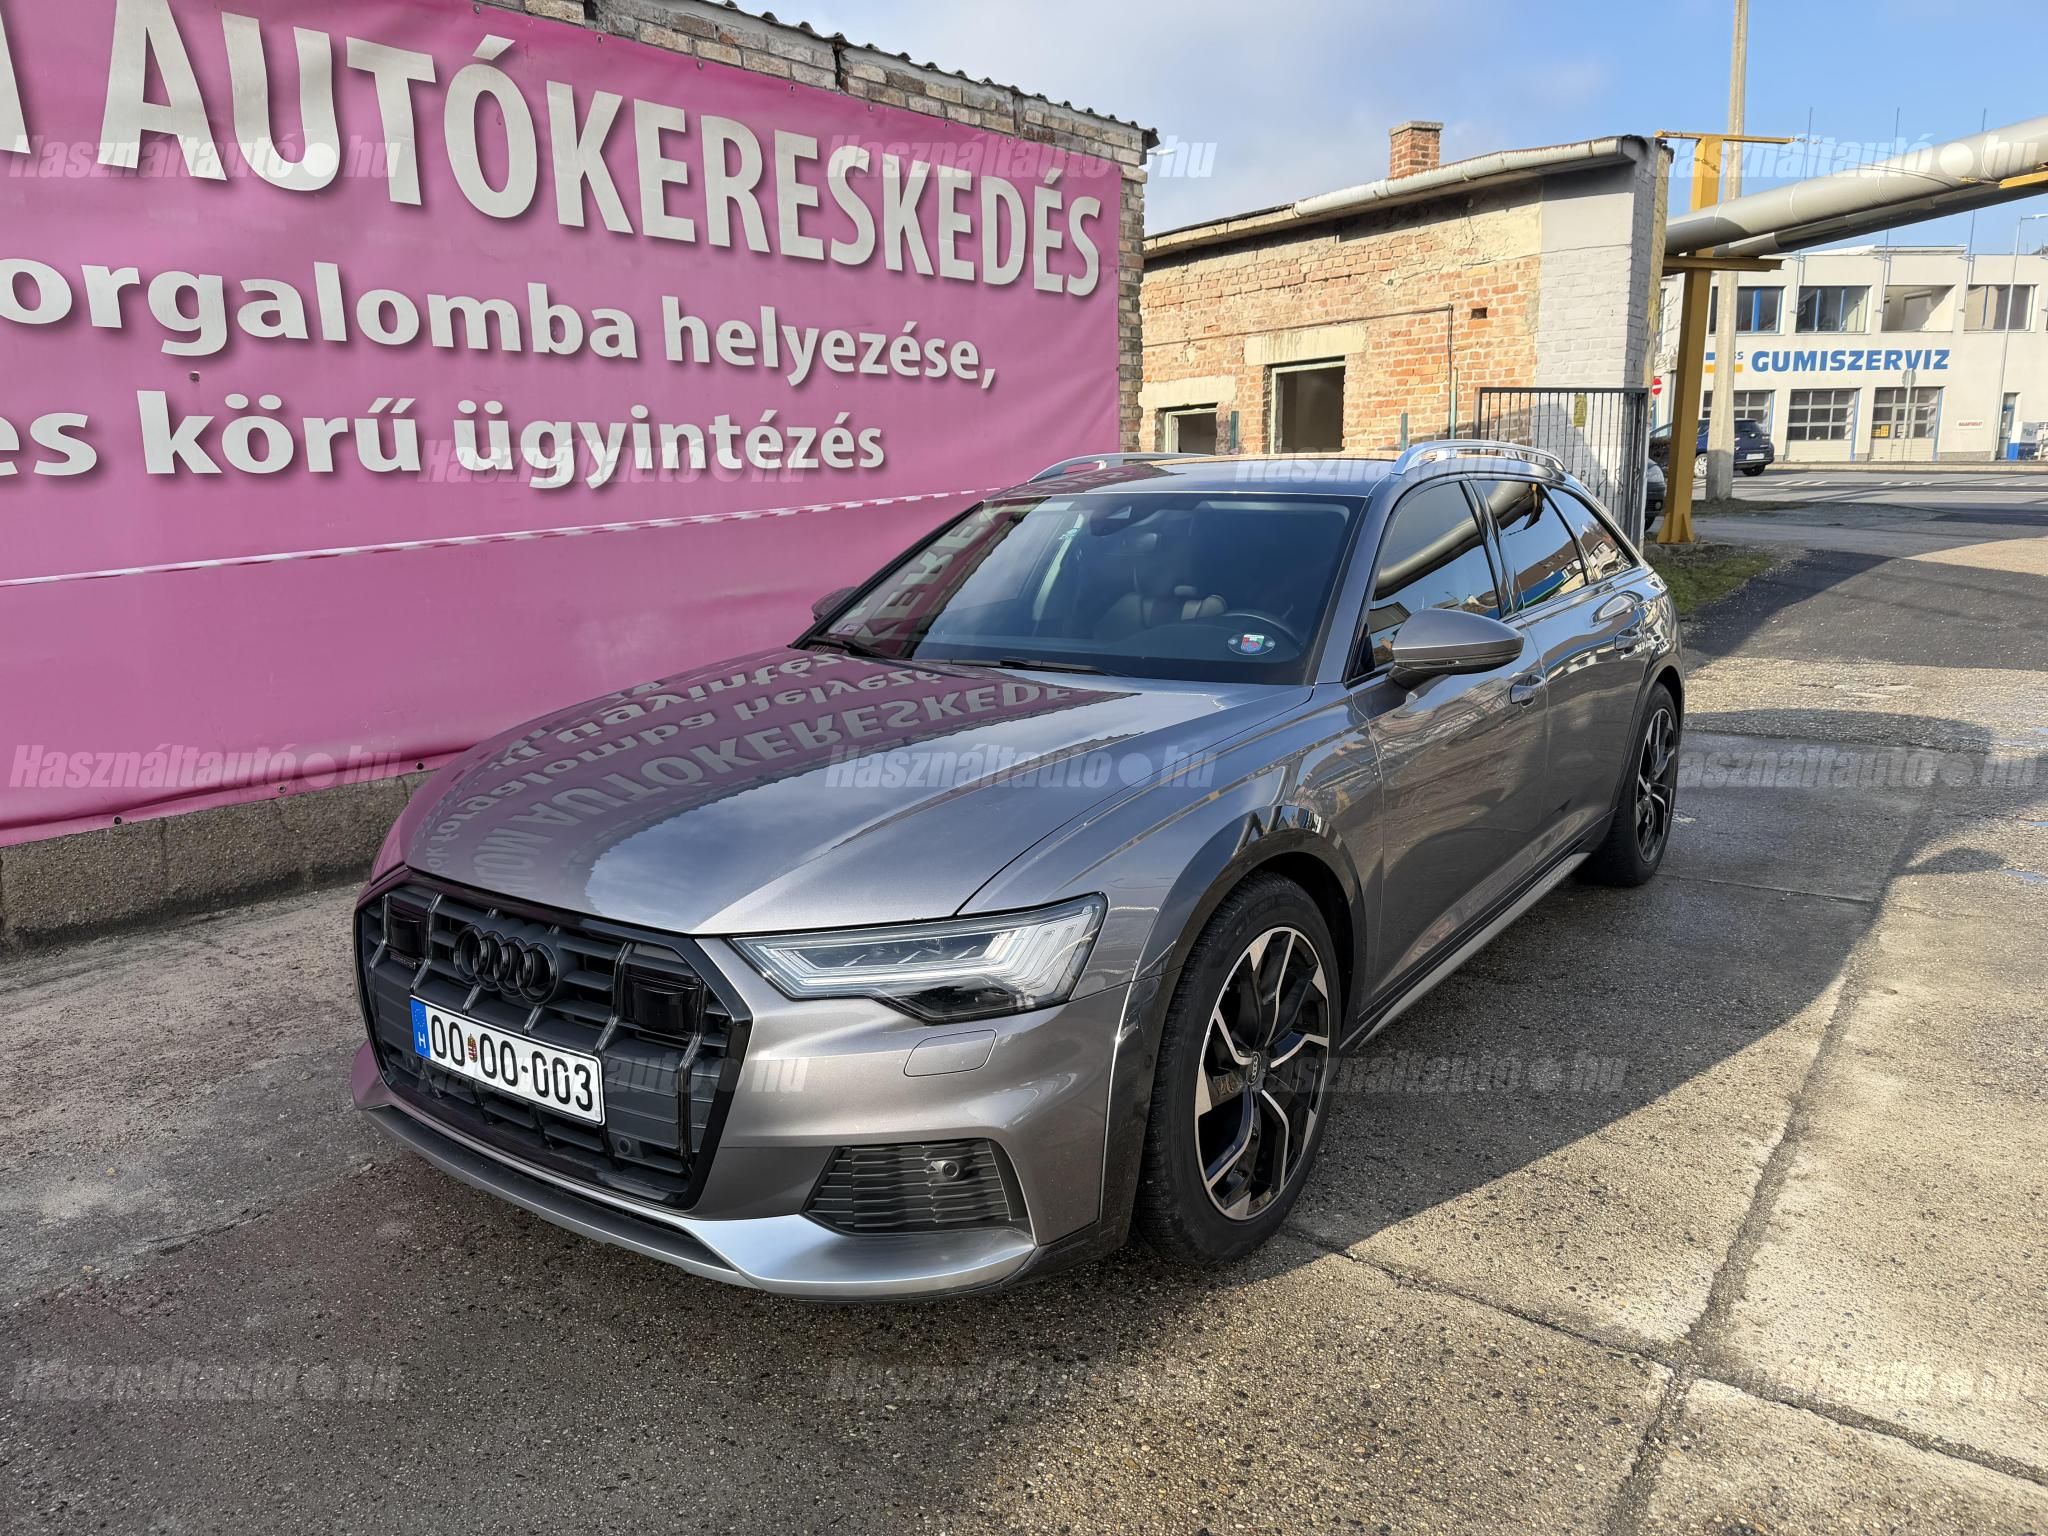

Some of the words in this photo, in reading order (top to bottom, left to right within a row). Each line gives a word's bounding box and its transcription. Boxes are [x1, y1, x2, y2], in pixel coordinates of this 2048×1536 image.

[97, 0, 1101, 297] AUTÓKERESKEDÉS
[661, 296, 997, 389] helyezése,
[1751, 348, 1950, 373] GUMISZERVIZ
[137, 390, 422, 475] körű
[453, 400, 885, 490] ügyintézés
[418, 1032, 426, 1049] H
